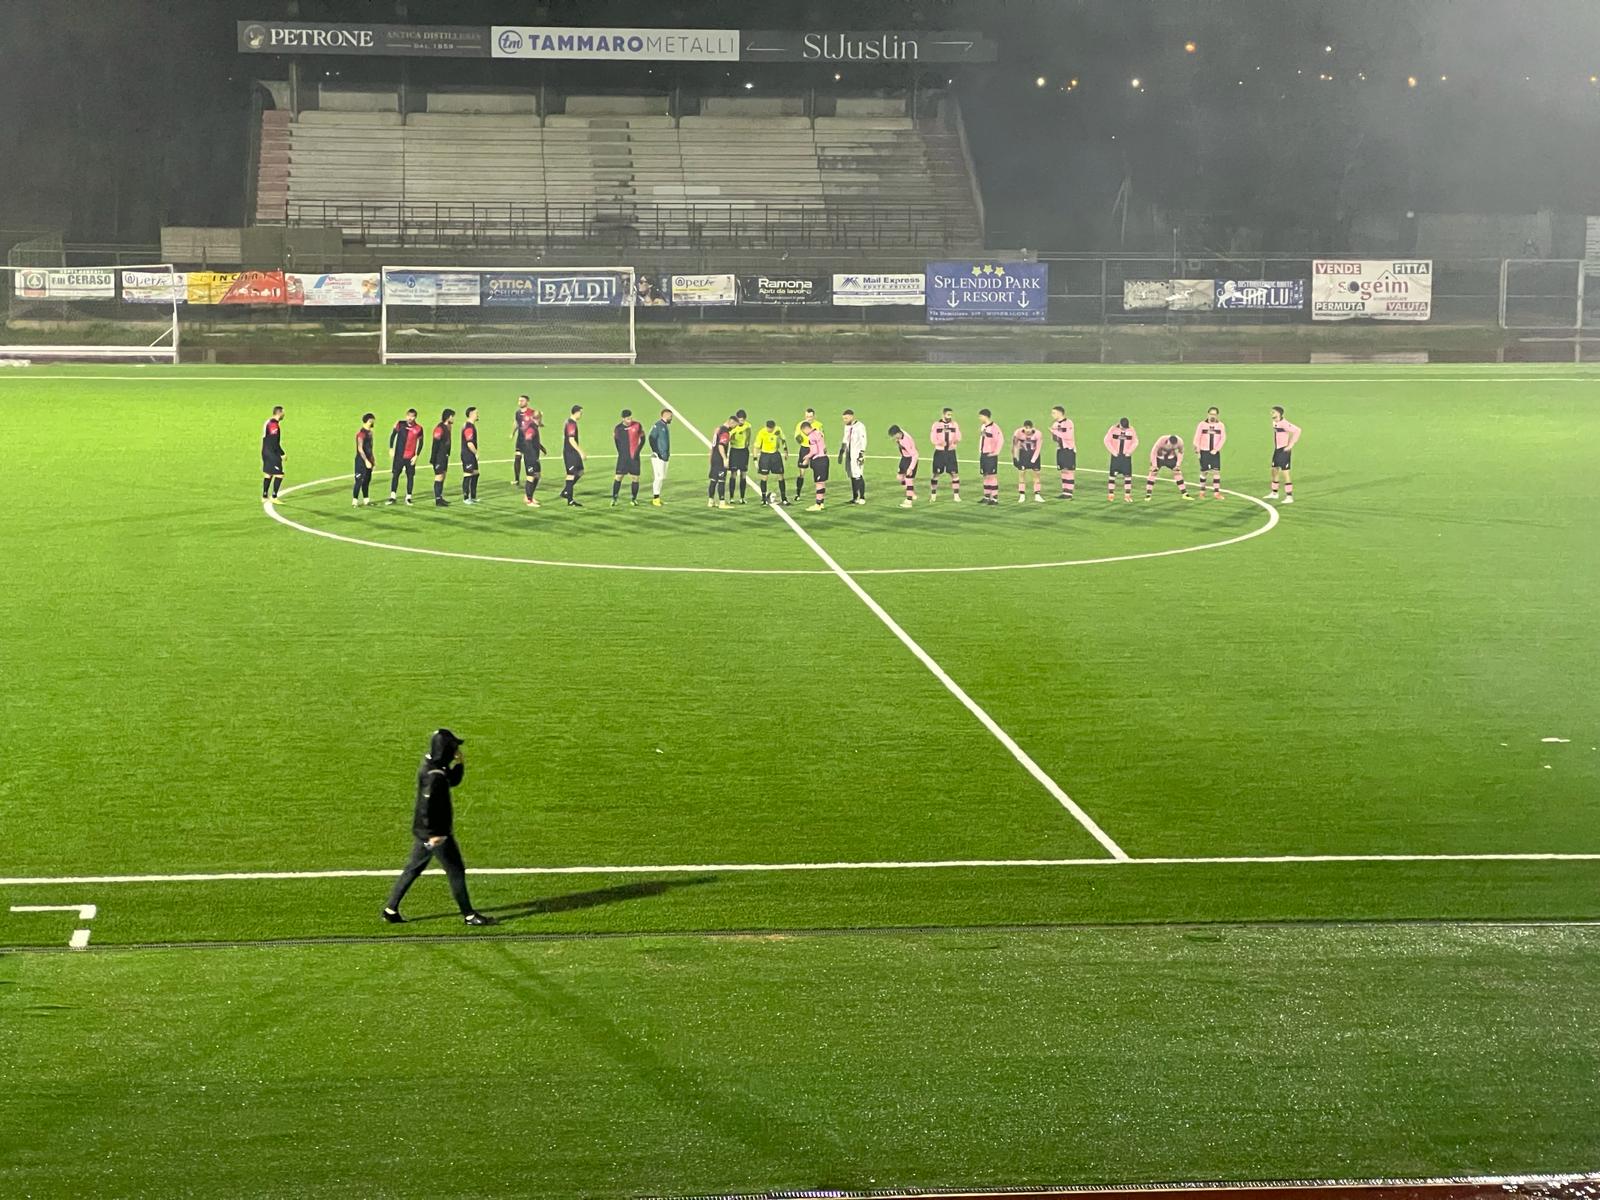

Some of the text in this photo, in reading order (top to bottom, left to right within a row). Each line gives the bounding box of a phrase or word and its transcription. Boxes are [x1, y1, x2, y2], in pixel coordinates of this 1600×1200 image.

[270, 28, 374, 46] PETRONE
[386, 31, 421, 39] ANTICA
[1317, 263, 1427, 274] VENDE FITTA
[67, 274, 112, 285] CERASO
[489, 280, 533, 289] OTTICA
[758, 278, 813, 289] Ramona
[883, 277, 921, 285] Express
[934, 275, 1041, 289] SPLENDID PARK
[544, 280, 609, 300] BALDI
[1338, 276, 1408, 301] sogeim
[963, 291, 1015, 303] RESORT
[1315, 302, 1427, 311] PERMUTA VALUTA
